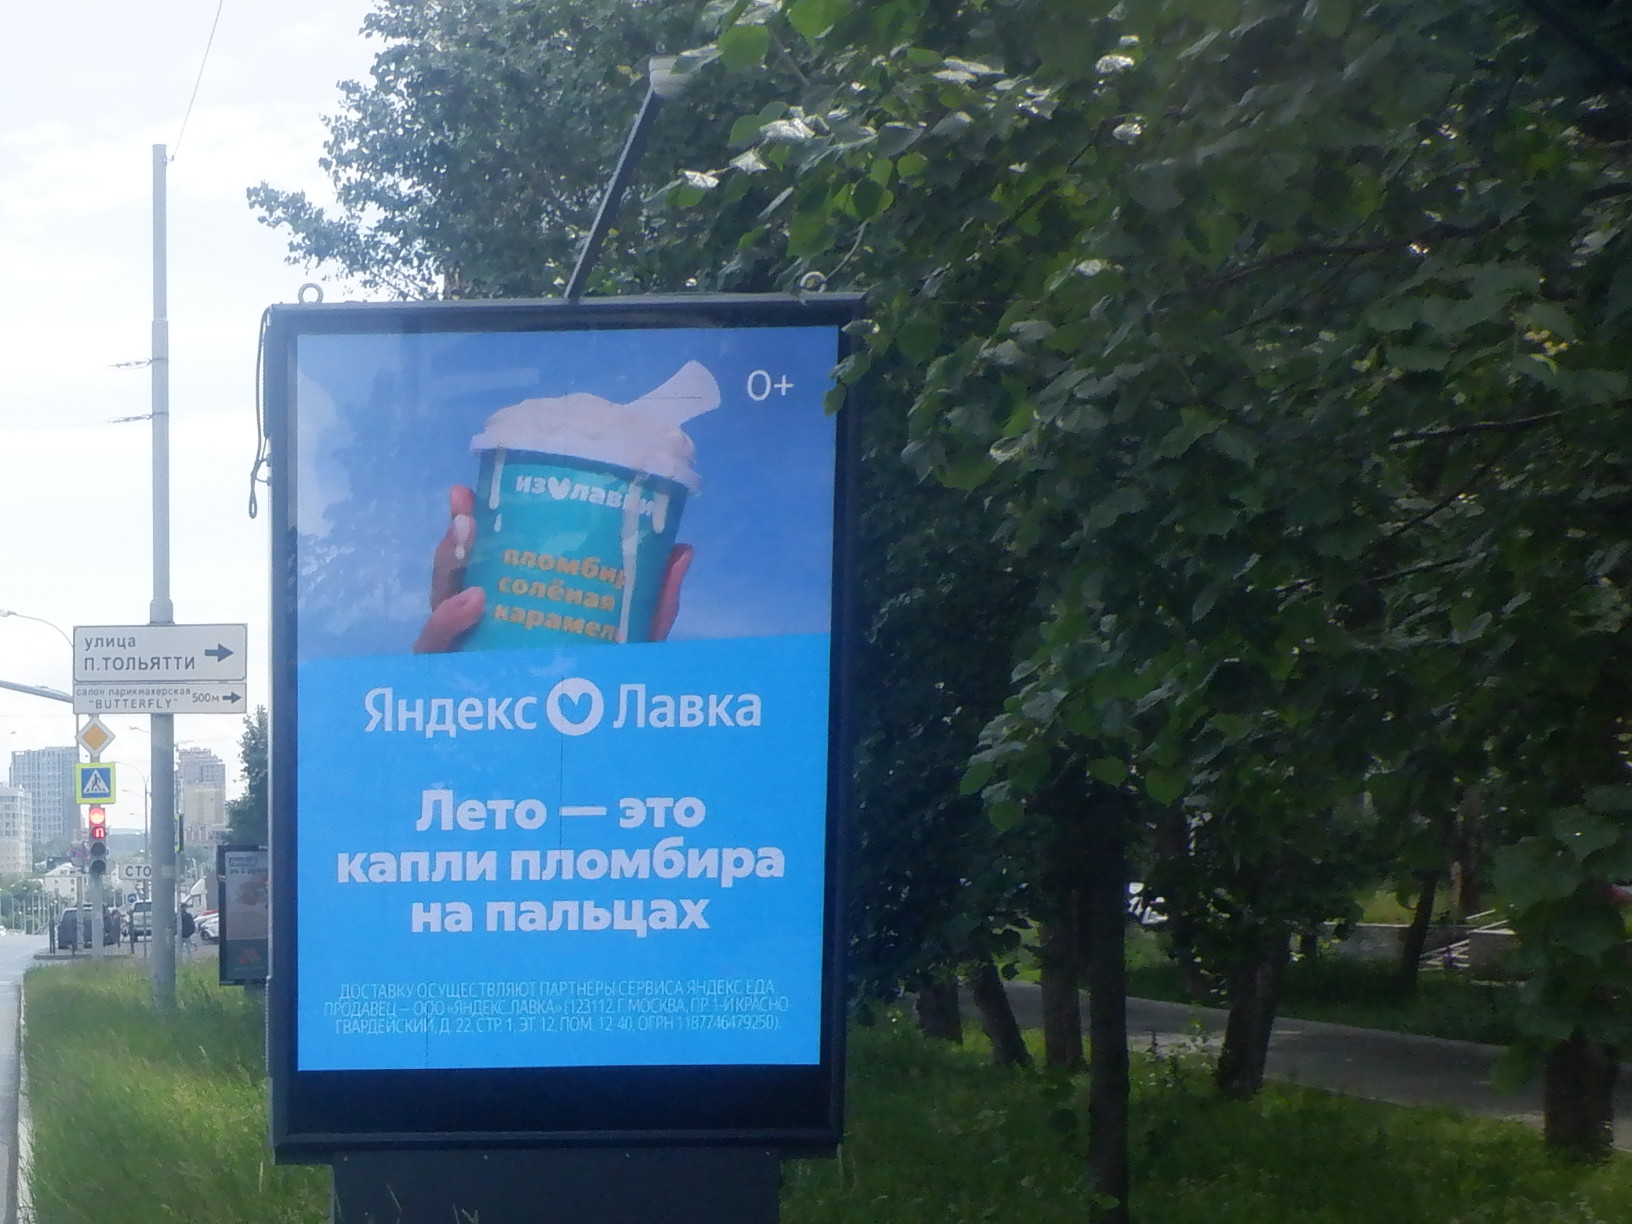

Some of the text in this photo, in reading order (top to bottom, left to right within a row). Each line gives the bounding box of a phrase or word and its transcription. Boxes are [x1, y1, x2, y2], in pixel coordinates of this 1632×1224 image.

[747, 369, 795, 401] 0+
[515, 475, 654, 517] из лави
[497, 576, 615, 611] солёная
[84, 636, 136, 651] улица
[84, 656, 195, 671] П.ТОЛЬЯТТИ
[76, 688, 191, 698] салон парикмахерская
[89, 698, 178, 709] "BUTTERFLY"
[364, 683, 762, 739] Яндекс Лавка
[416, 789, 547, 831] Лето
[620, 797, 706, 829] это
[337, 836, 785, 888] капли пломбира
[411, 898, 710, 938] на пальцах
[339, 982, 414, 1000] ДОСТАВКУ
[416, 982, 536, 998] ОСУЩЕСТВЛЯЮТ
[540, 981, 615, 996] ПАРТНЕРЫ
[618, 980, 683, 995] СЕРВИСА
[687, 979, 743, 996] ЯНДЕКС
[324, 1000, 396, 1017] ПРОДАВЕЦ
[413, 1000, 444, 1016] ООО
[638, 1015, 674, 1031] ОГРН
